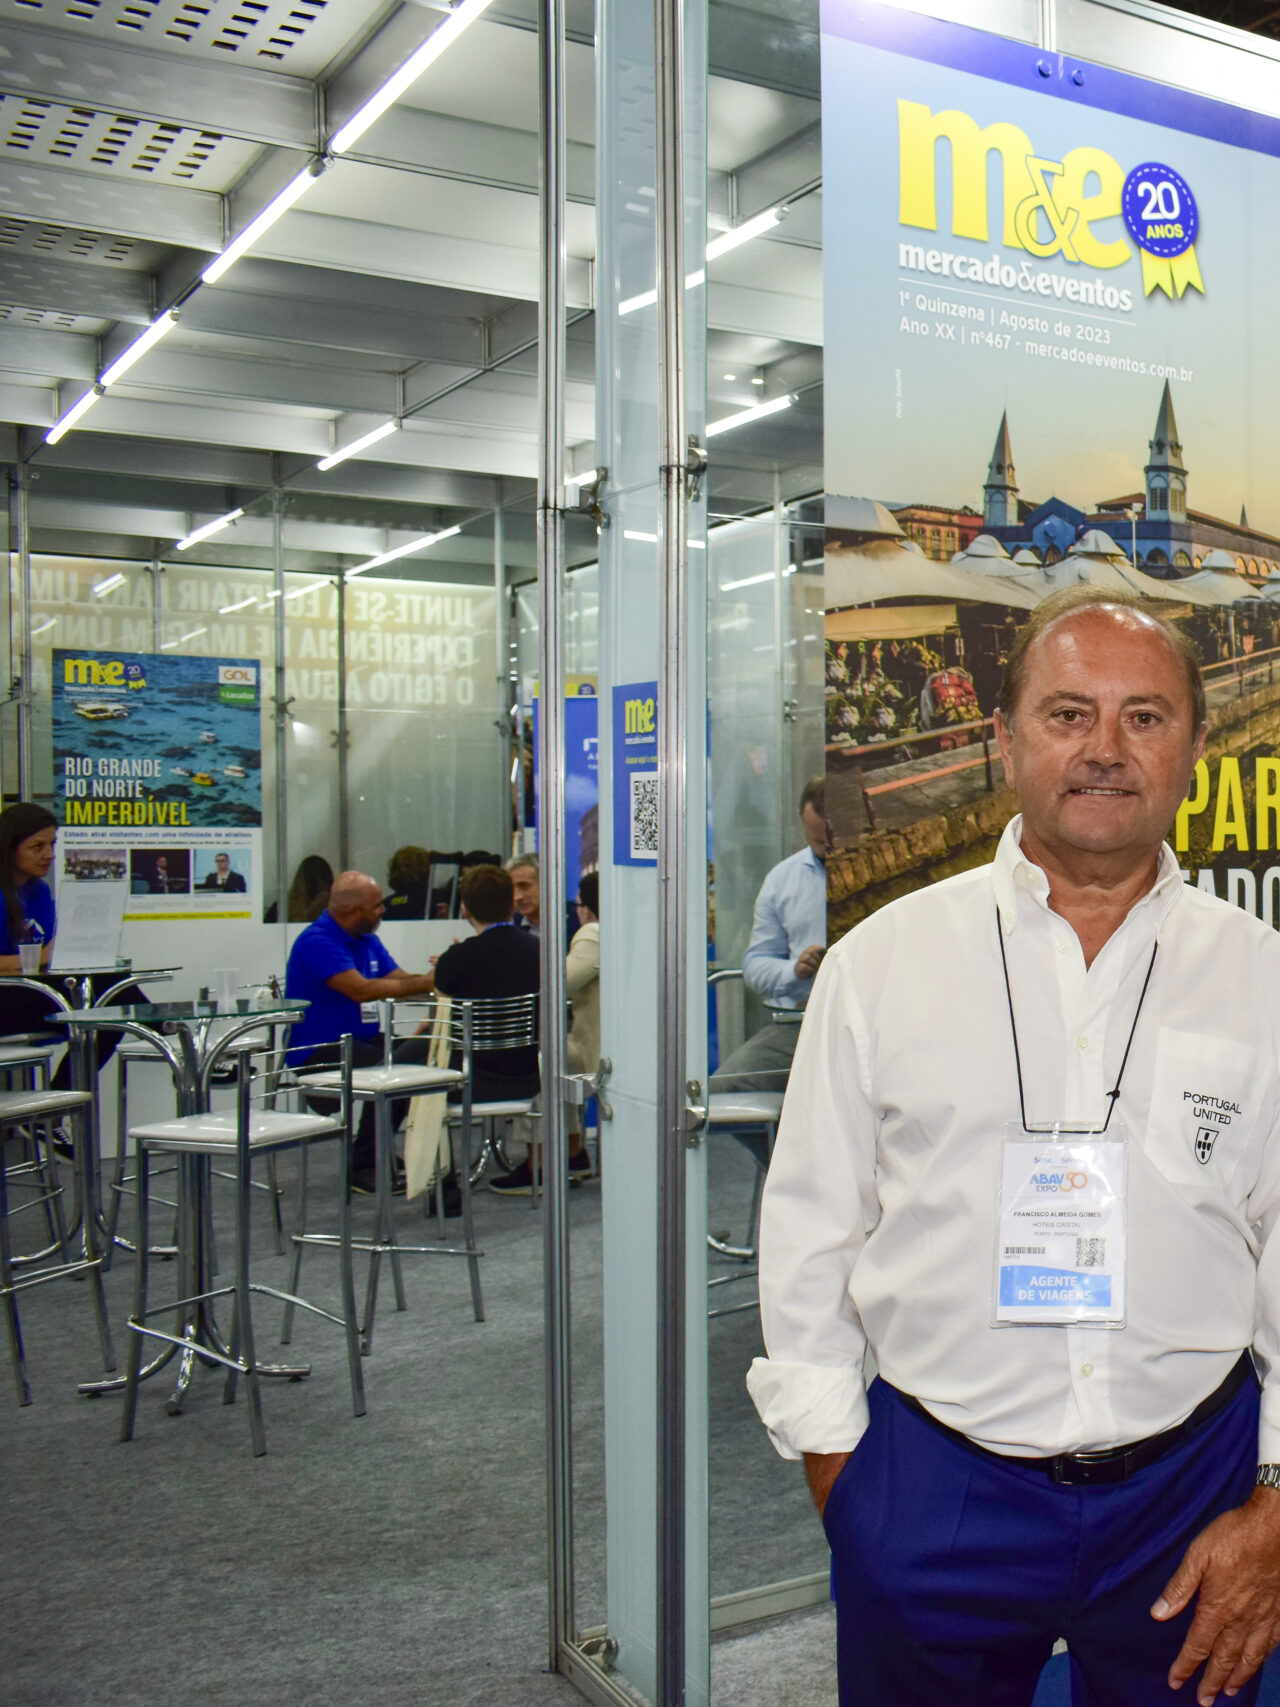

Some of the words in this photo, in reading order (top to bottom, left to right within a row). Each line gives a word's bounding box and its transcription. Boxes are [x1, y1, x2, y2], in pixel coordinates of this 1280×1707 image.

[1137, 181, 1180, 220] 20
[1146, 223, 1184, 240] ANOS
[898, 243, 1133, 312] mercado&eventos
[915, 294, 985, 322] Quinzena
[1000, 309, 1049, 334] Agosto
[1054, 318, 1071, 337] de
[1076, 323, 1111, 345] 2023
[899, 316, 929, 336] Ano
[934, 320, 956, 341] XX
[1025, 339, 1194, 383] mercadoeeventos.com.br
[223, 669, 251, 681] GOL
[65, 757, 92, 776] RIO
[99, 758, 162, 777] GRANDE
[65, 779, 87, 797] DO
[92, 780, 143, 797] NORTE
[66, 795, 191, 825] IMPERDÍVEL
[1183, 1091, 1242, 1114] PORTUGAL
[1193, 1107, 1232, 1125] UNITED
[1030, 1275, 1078, 1287] AGENTE
[1018, 1290, 1035, 1300] DE
[1038, 1289, 1092, 1300] VIAGENS
